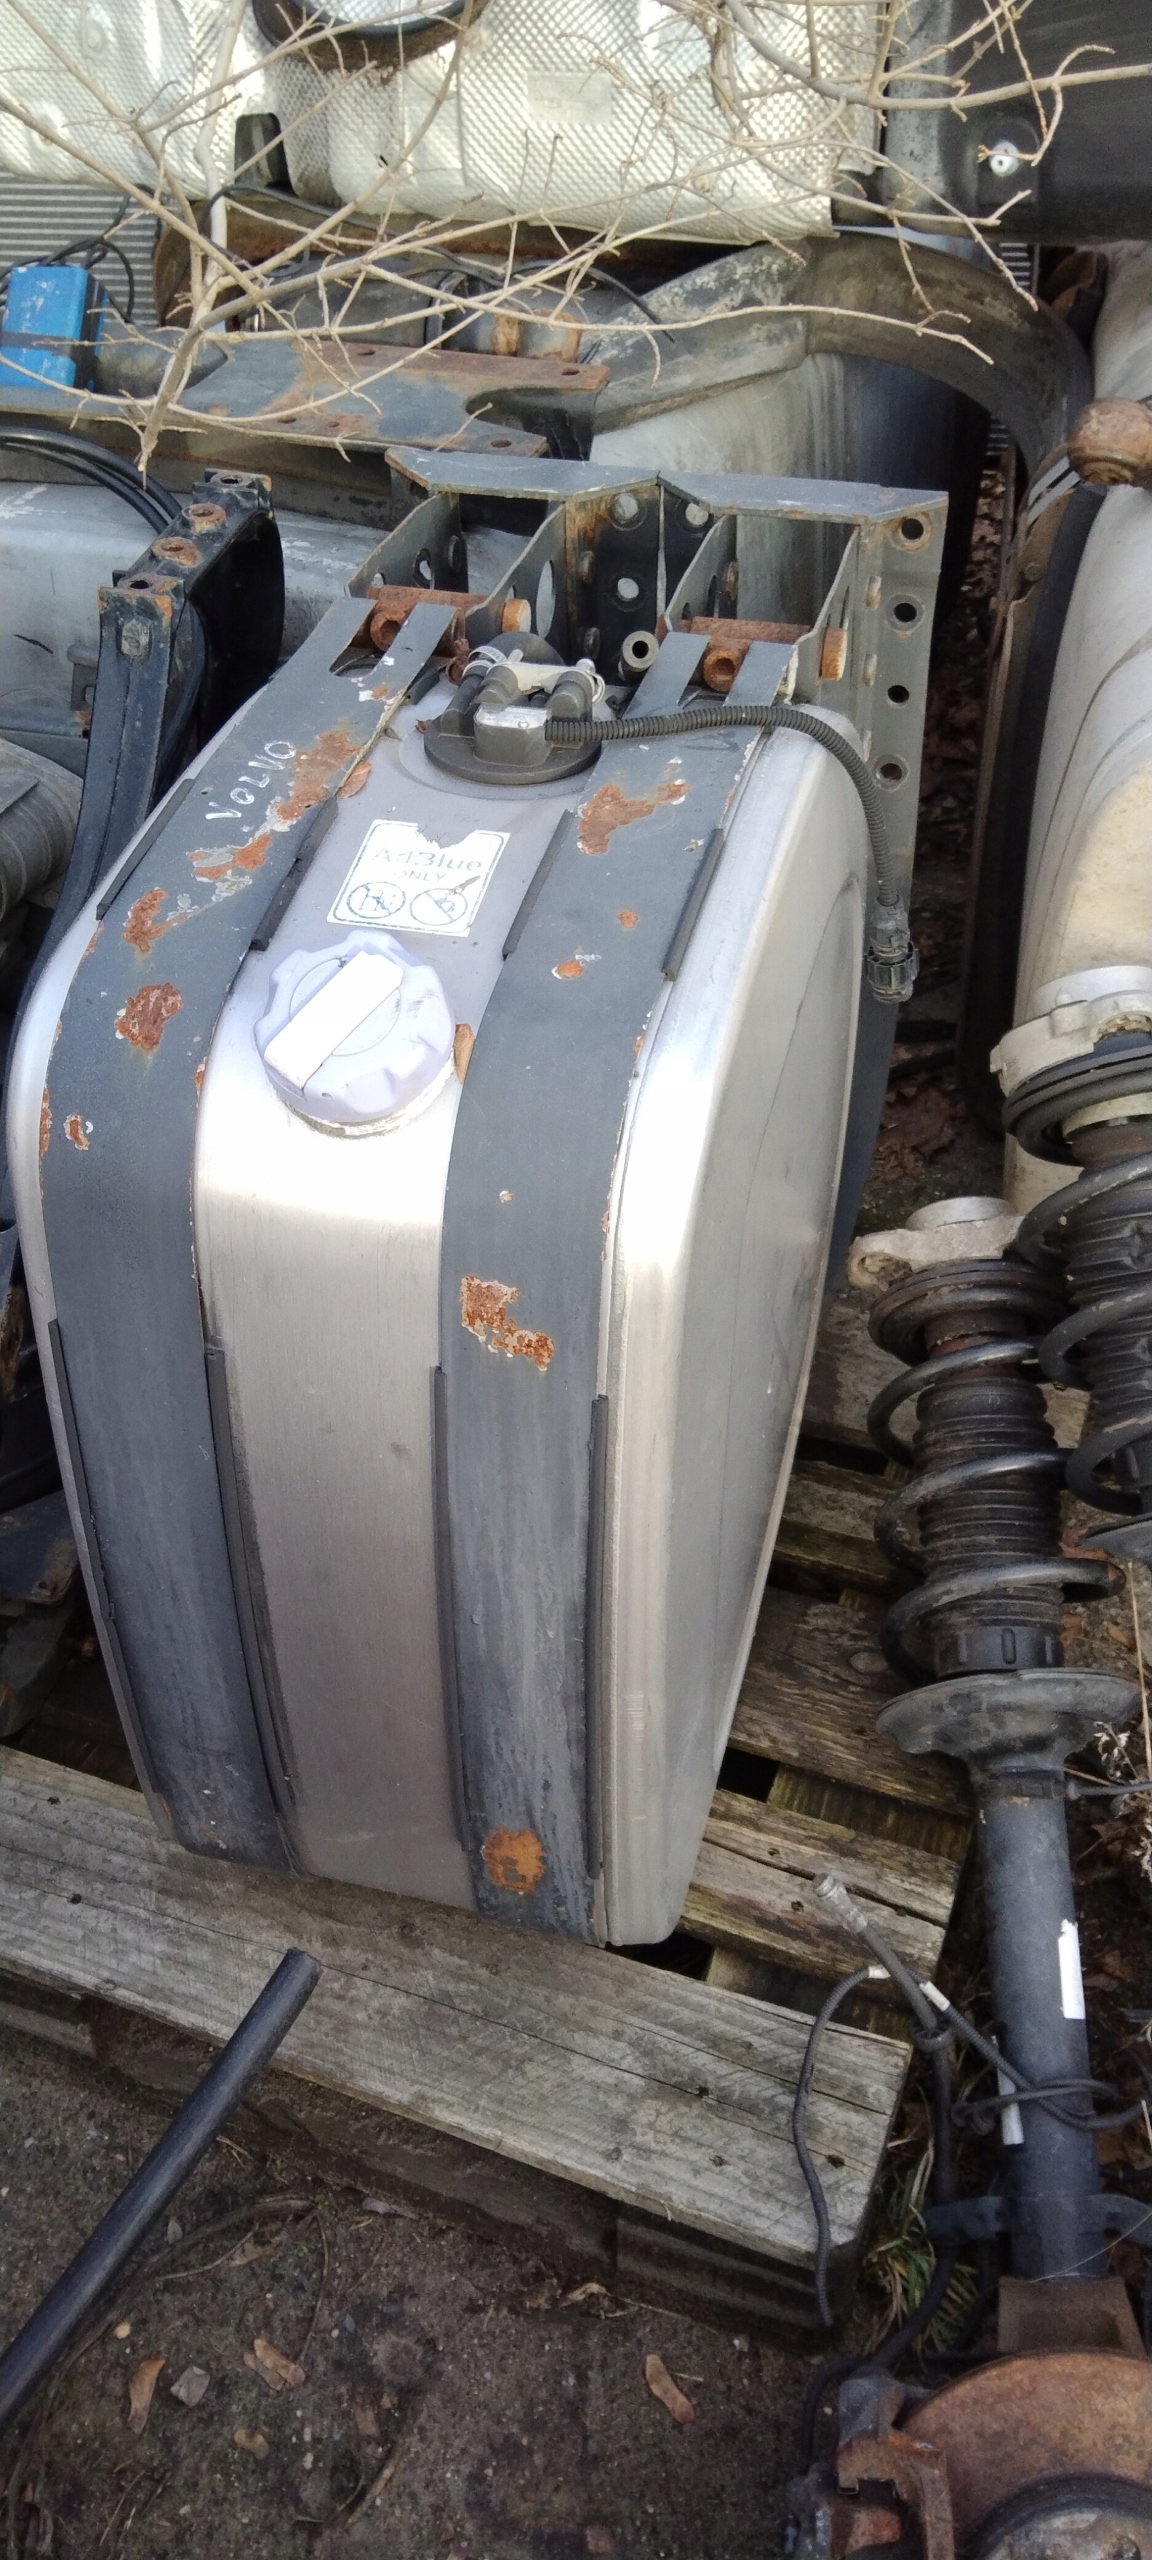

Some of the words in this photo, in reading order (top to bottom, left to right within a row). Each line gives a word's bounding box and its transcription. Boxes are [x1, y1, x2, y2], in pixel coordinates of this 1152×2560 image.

[205, 740, 297, 820] VOLVO
[371, 847, 482, 872] AdBlue
[393, 869, 447, 882] ONLY
